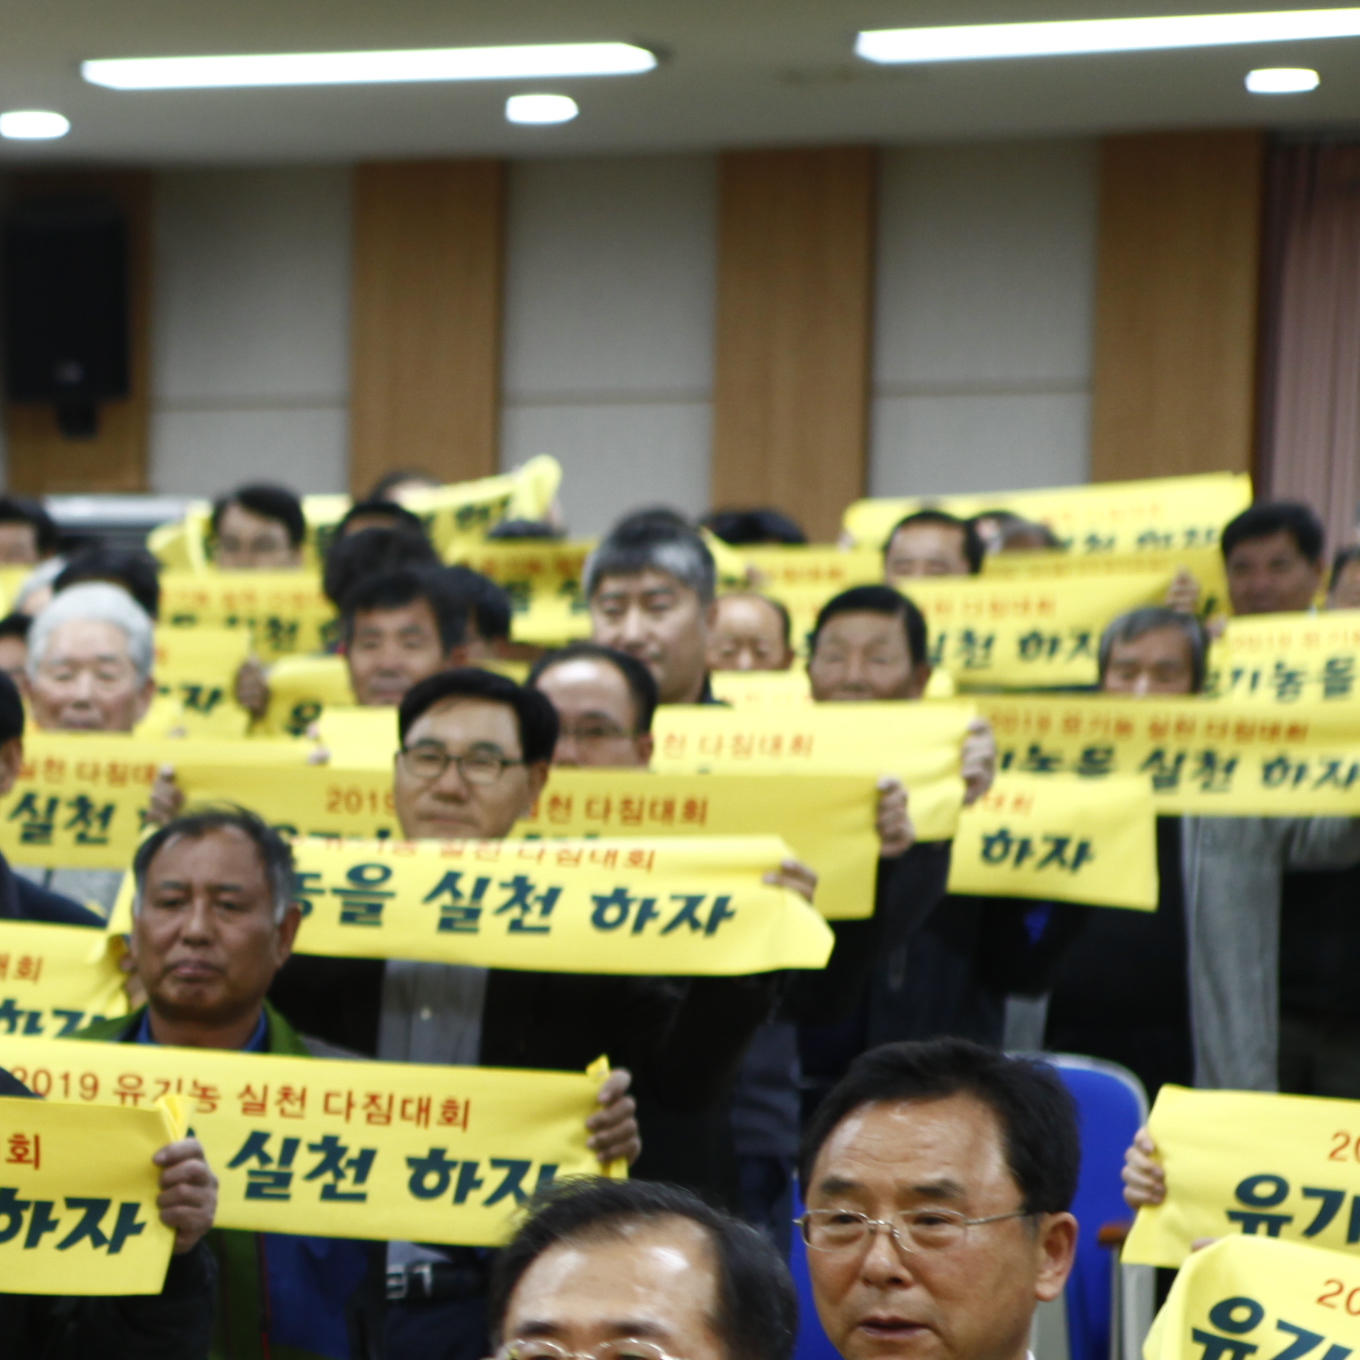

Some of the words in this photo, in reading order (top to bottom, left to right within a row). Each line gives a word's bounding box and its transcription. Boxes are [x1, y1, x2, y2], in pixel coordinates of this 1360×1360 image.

[75, 762, 157, 787] 다짐대
[1138, 746, 1238, 792] 실천
[1261, 748, 1360, 792] 하자
[7, 791, 116, 845] 실천
[585, 793, 708, 825] 다짐대회
[980, 826, 1095, 873] 하자
[292, 862, 397, 928] 농을
[422, 870, 563, 935] 실천
[590, 887, 737, 938] 하자
[236, 1082, 309, 1119] 실천
[322, 1089, 473, 1131] 다짐대회
[227, 1131, 378, 1203] 실천
[404, 1148, 560, 1210] 하자
